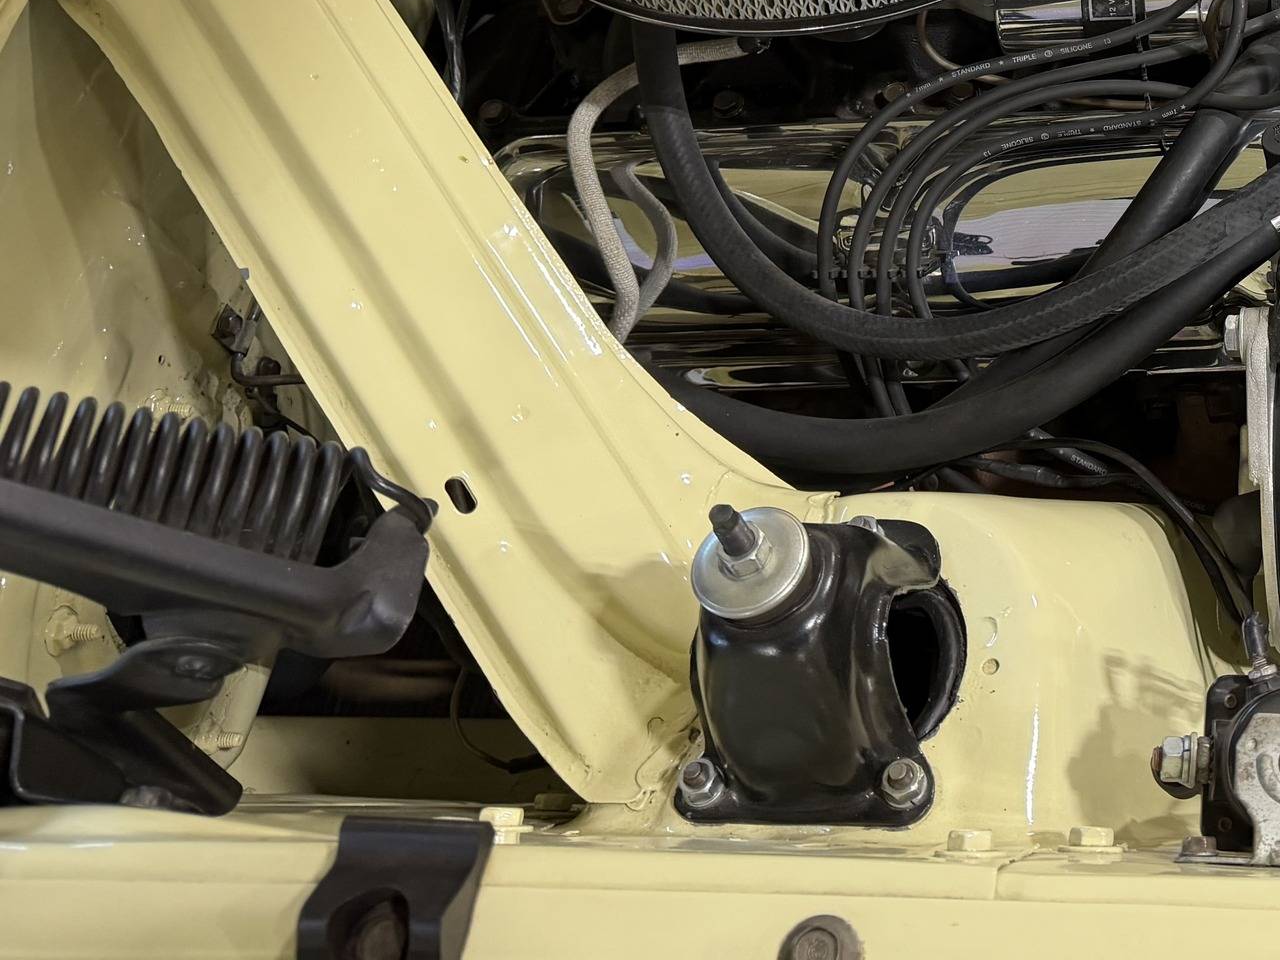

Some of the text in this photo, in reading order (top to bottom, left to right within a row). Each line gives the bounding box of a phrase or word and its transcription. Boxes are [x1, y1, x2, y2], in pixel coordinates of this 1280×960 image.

[1109, 7, 1117, 17] 12
[952, 62, 991, 79] STANDARD
[1012, 53, 1038, 64] TRIPLE
[1060, 43, 1093, 55] SILICONE
[1103, 120, 1143, 132] STANDARD
[1001, 136, 1035, 151] SILICONE
